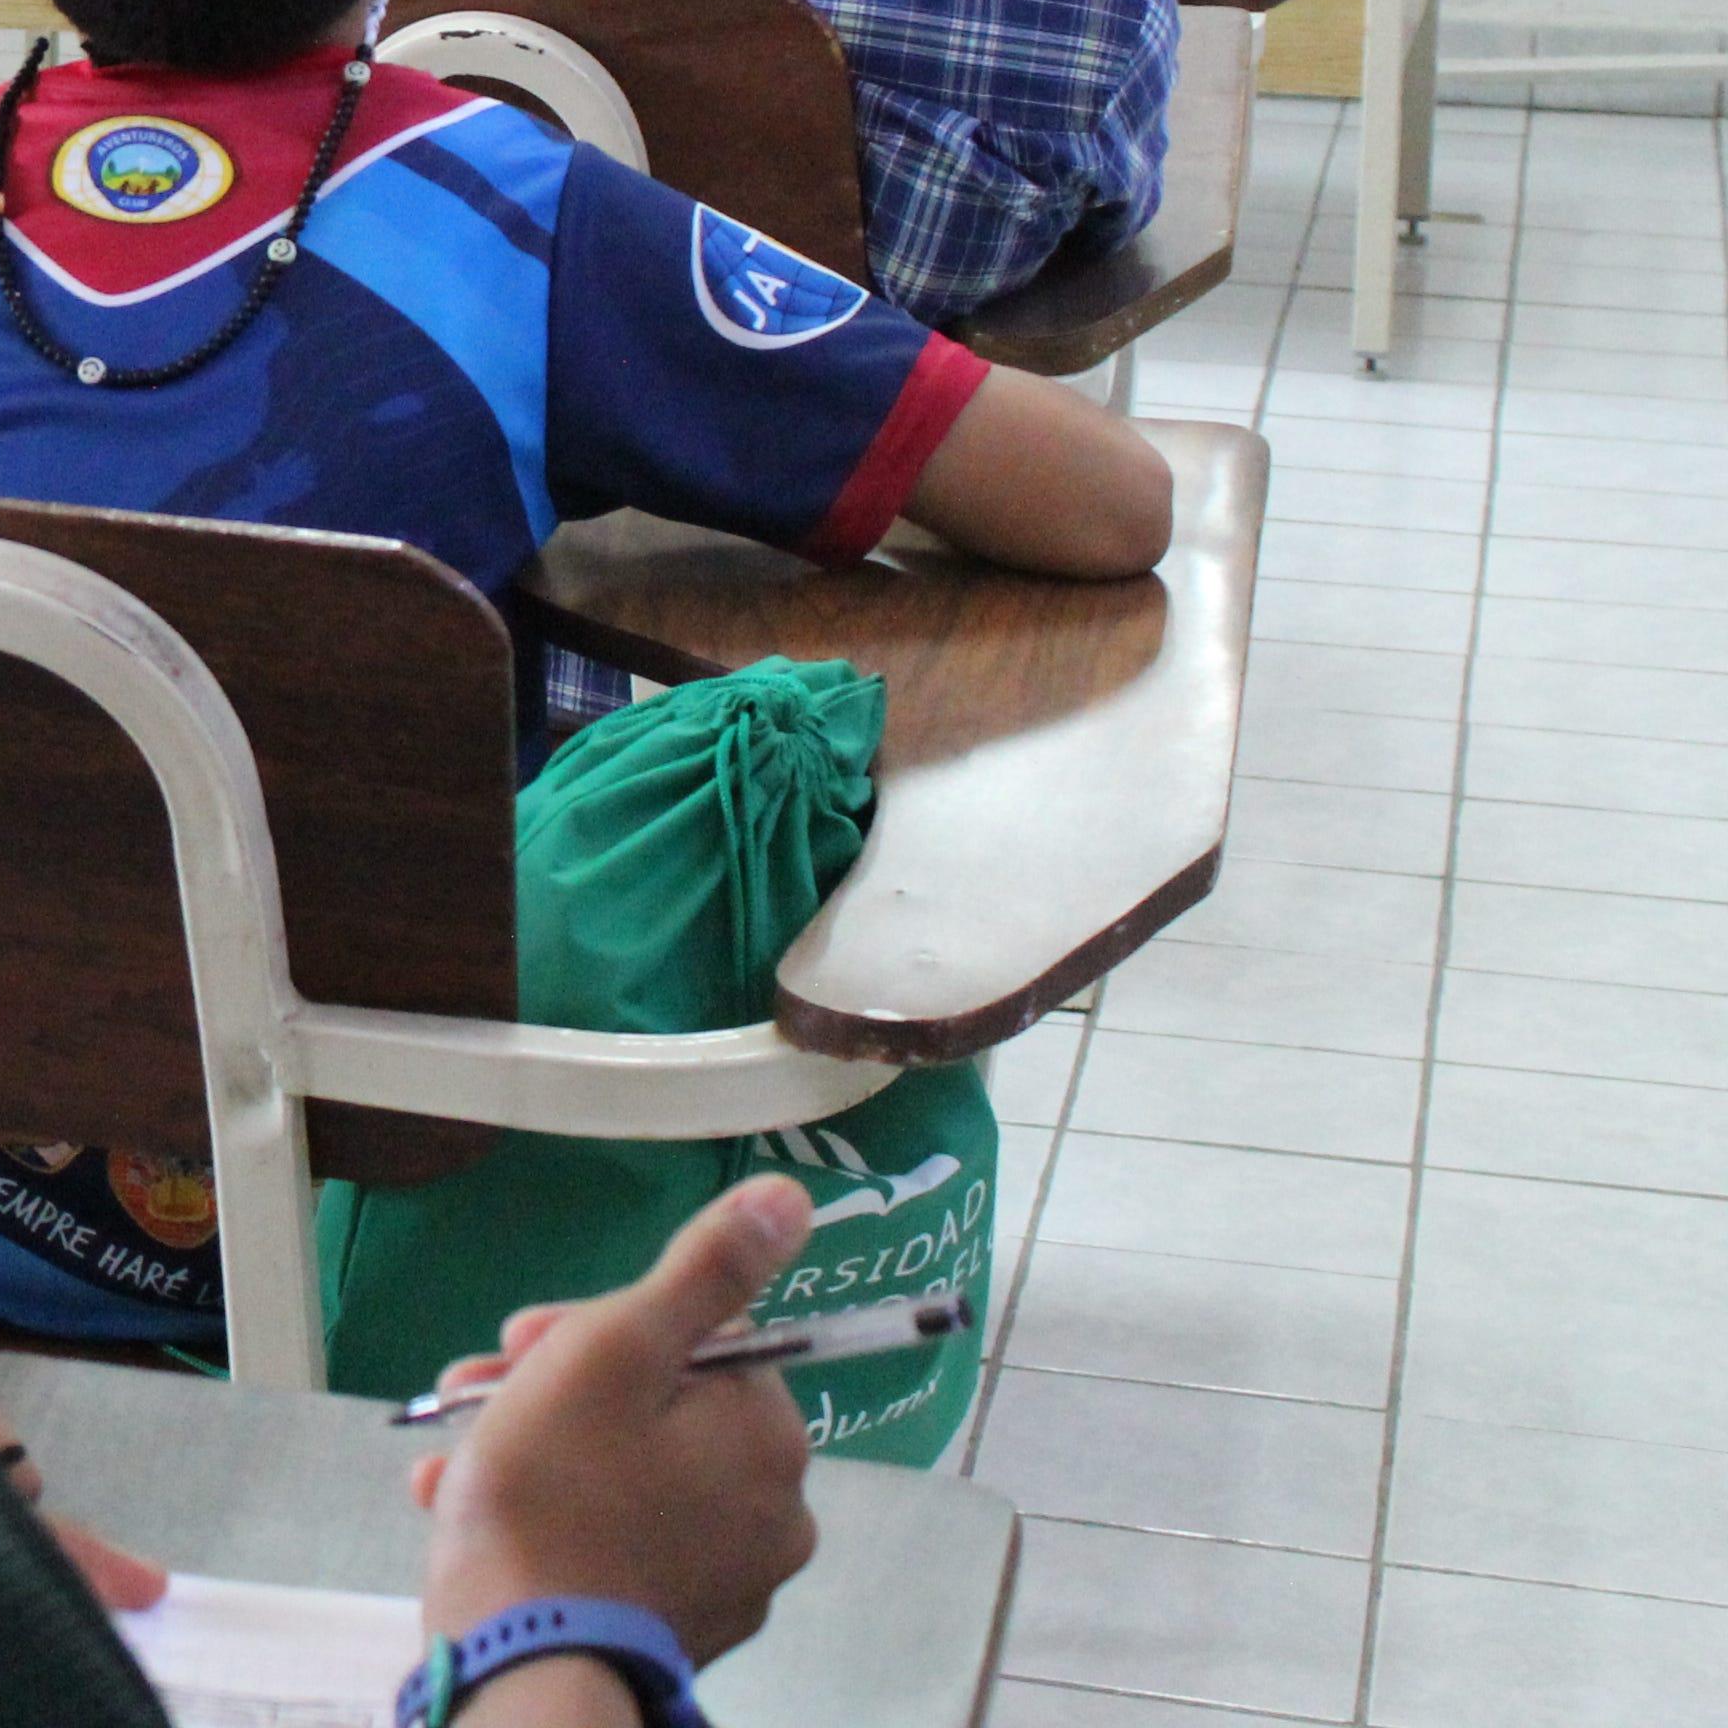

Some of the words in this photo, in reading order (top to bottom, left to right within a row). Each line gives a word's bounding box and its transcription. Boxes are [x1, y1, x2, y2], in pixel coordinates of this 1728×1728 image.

[97, 128, 190, 162] AVENTUREROS
[98, 1246, 190, 1302] HARÉ
[746, 1179, 986, 1309] ERSIDAD
[806, 1368, 943, 1449] du.mx
